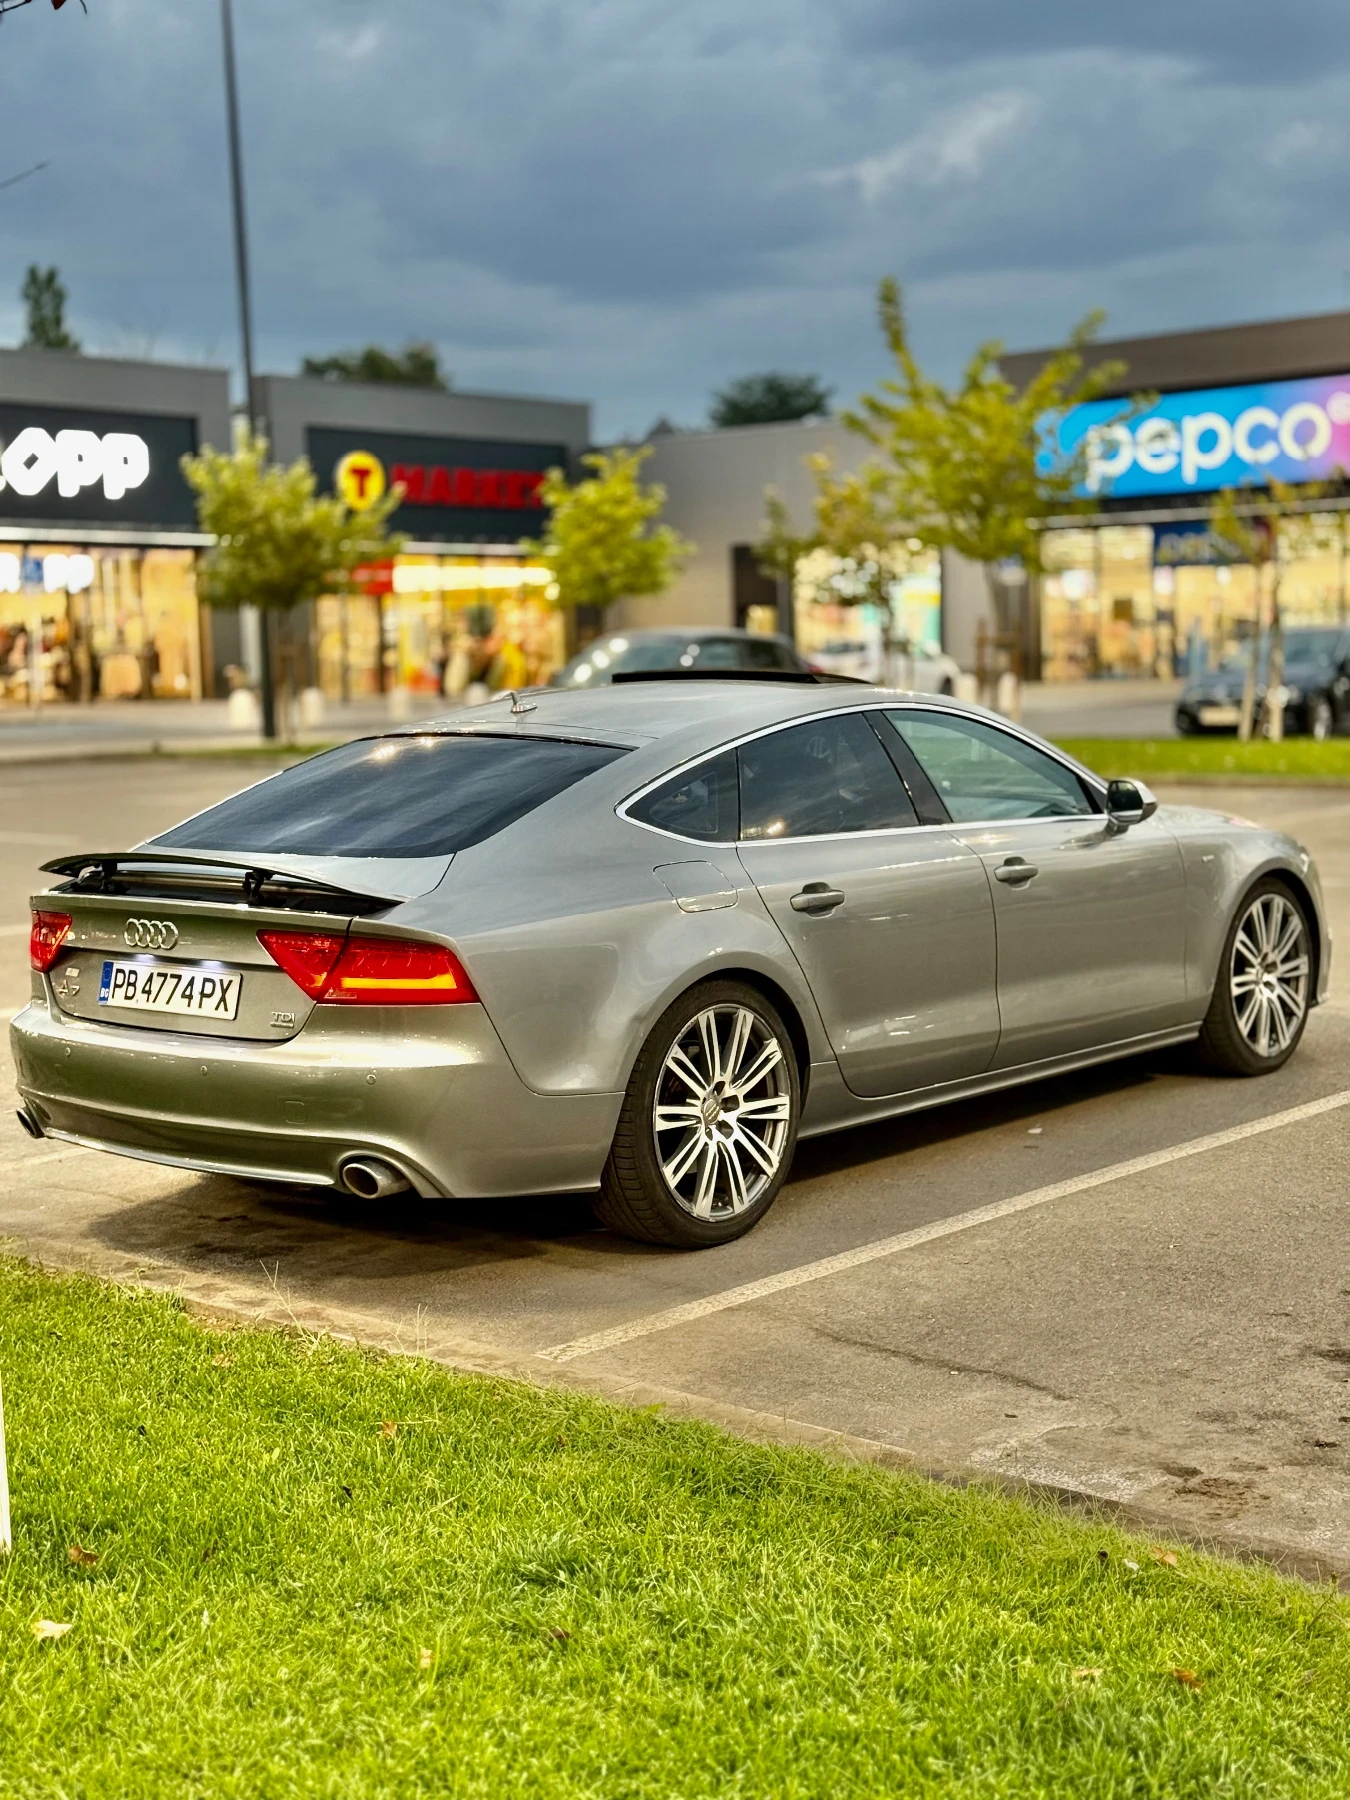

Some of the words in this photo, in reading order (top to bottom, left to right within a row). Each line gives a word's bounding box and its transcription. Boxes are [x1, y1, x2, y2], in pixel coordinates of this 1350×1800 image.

[0, 427, 149, 500] opp
[1085, 402, 1332, 492] pepco
[350, 467, 371, 499] T
[271, 1011, 295, 1023] TDI
